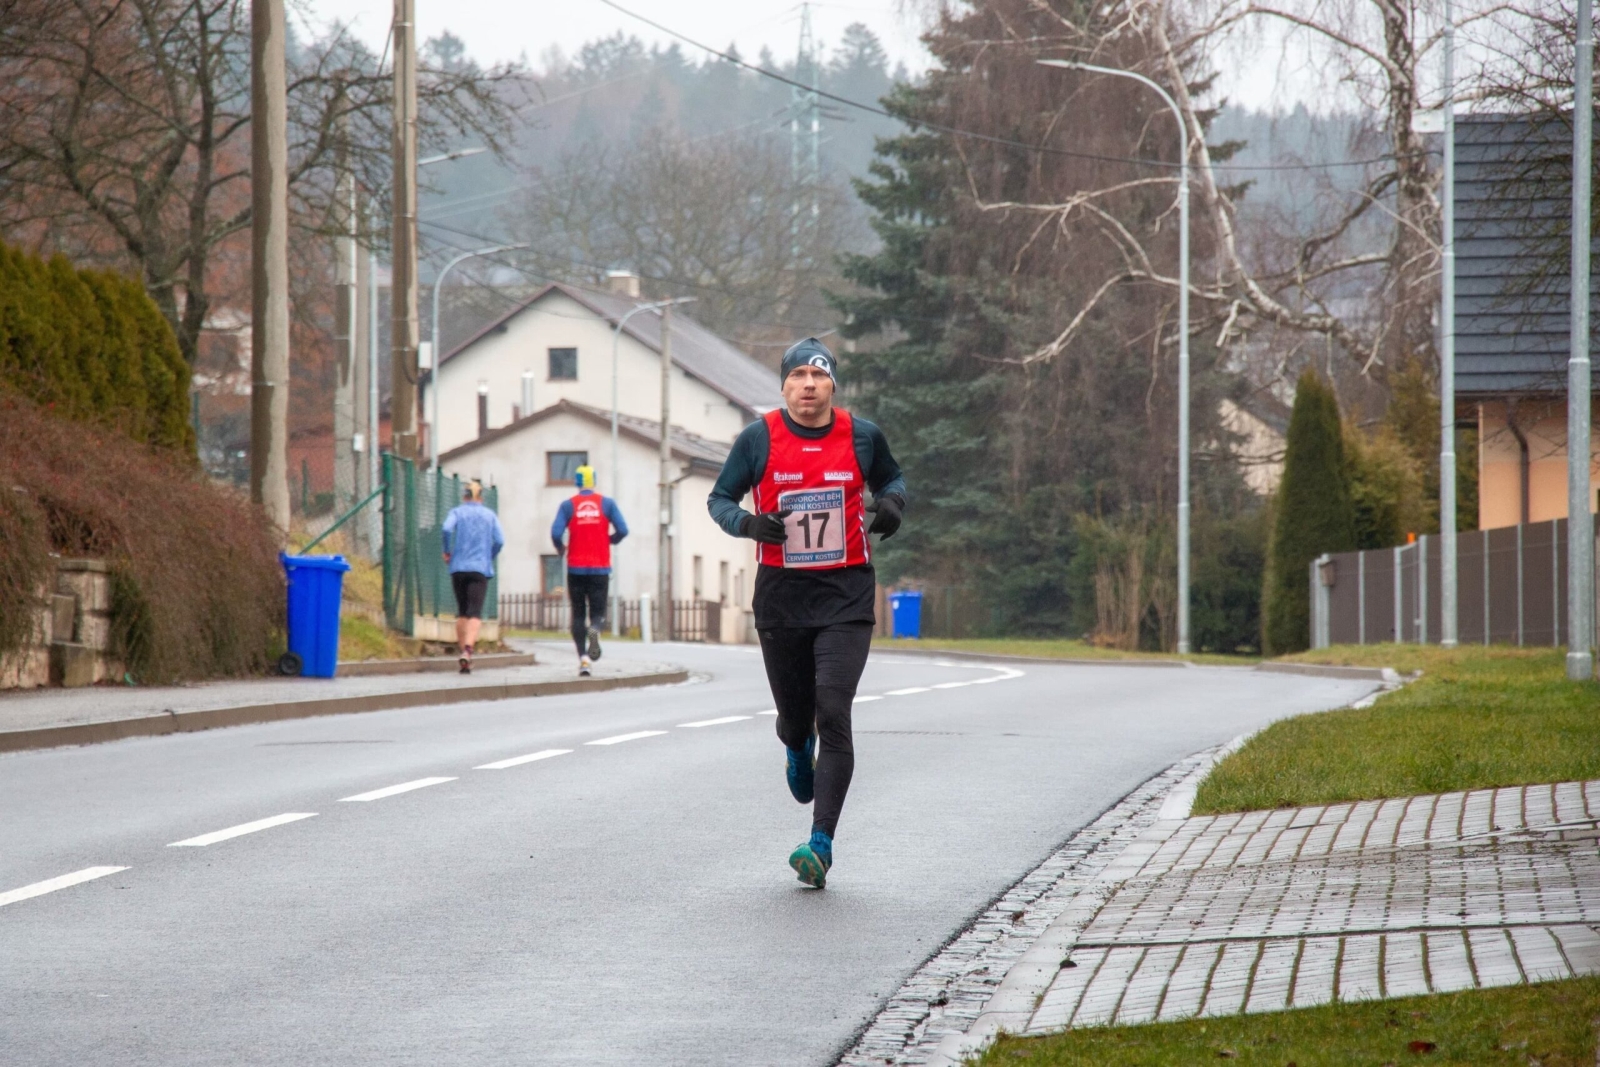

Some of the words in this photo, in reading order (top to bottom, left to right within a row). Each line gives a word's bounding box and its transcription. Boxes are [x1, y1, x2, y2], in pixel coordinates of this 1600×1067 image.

[782, 494, 825, 504] NOVOROČNÍ
[782, 502, 806, 511] HORNÍ
[807, 500, 841, 510] KOSTELEC
[797, 512, 830, 549] 17
[786, 553, 813, 562] ČERVENÝ
[815, 552, 843, 560] KOSTELEC
